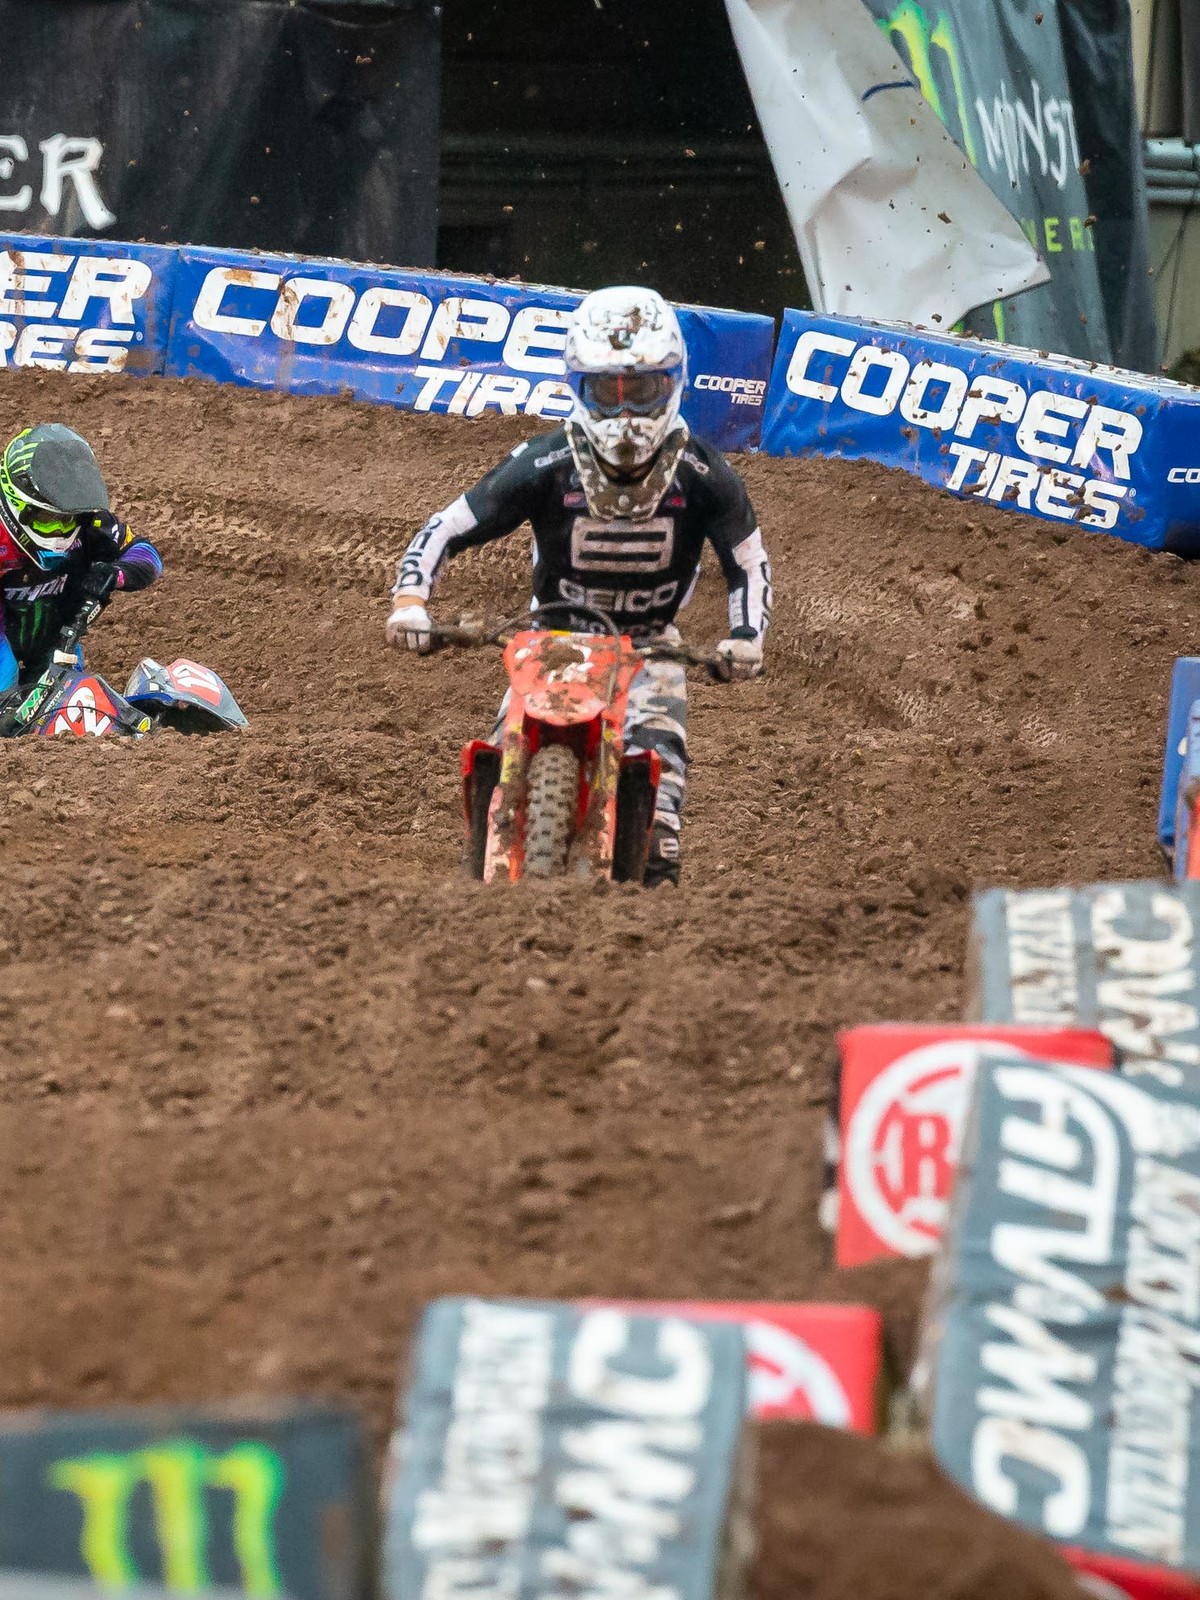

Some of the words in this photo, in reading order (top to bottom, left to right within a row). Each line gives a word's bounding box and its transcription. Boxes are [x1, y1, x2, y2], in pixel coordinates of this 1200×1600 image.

[192, 266, 574, 376] COOPE
[413, 365, 574, 421] TIRE
[693, 374, 767, 395] COOPER
[730, 392, 765, 406] TIRES
[785, 330, 1144, 481] COOPER
[945, 441, 1129, 530] TIRES
[559, 578, 679, 613] GEICO
